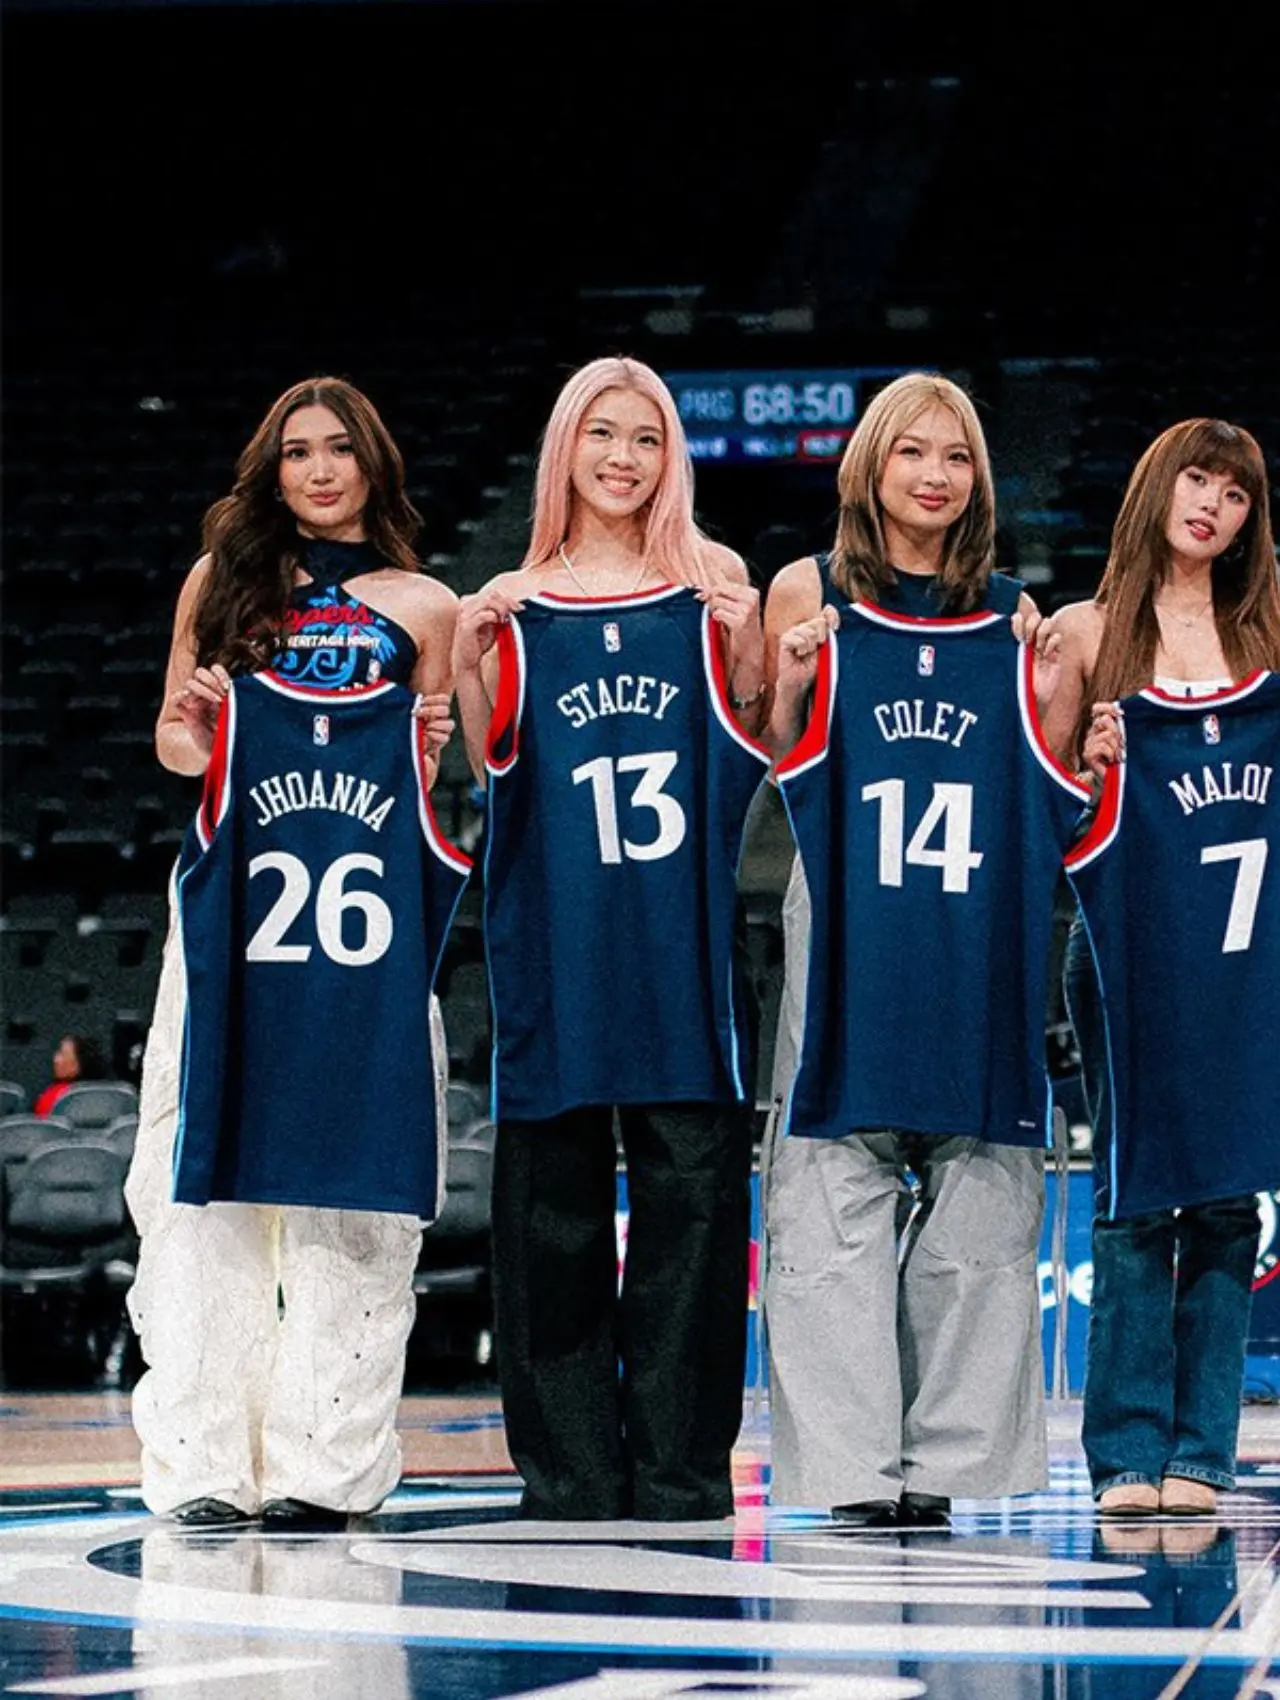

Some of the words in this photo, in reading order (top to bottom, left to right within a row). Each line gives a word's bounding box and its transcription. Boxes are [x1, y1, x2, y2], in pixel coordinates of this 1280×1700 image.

[556, 675, 680, 728] STACEY
[873, 699, 978, 747] COLET
[249, 769, 395, 832] JHOANNA
[571, 750, 686, 864] 13
[1168, 762, 1273, 815] MALOI
[861, 778, 984, 893] 14
[245, 851, 393, 966] 26
[1200, 838, 1268, 953] 7
